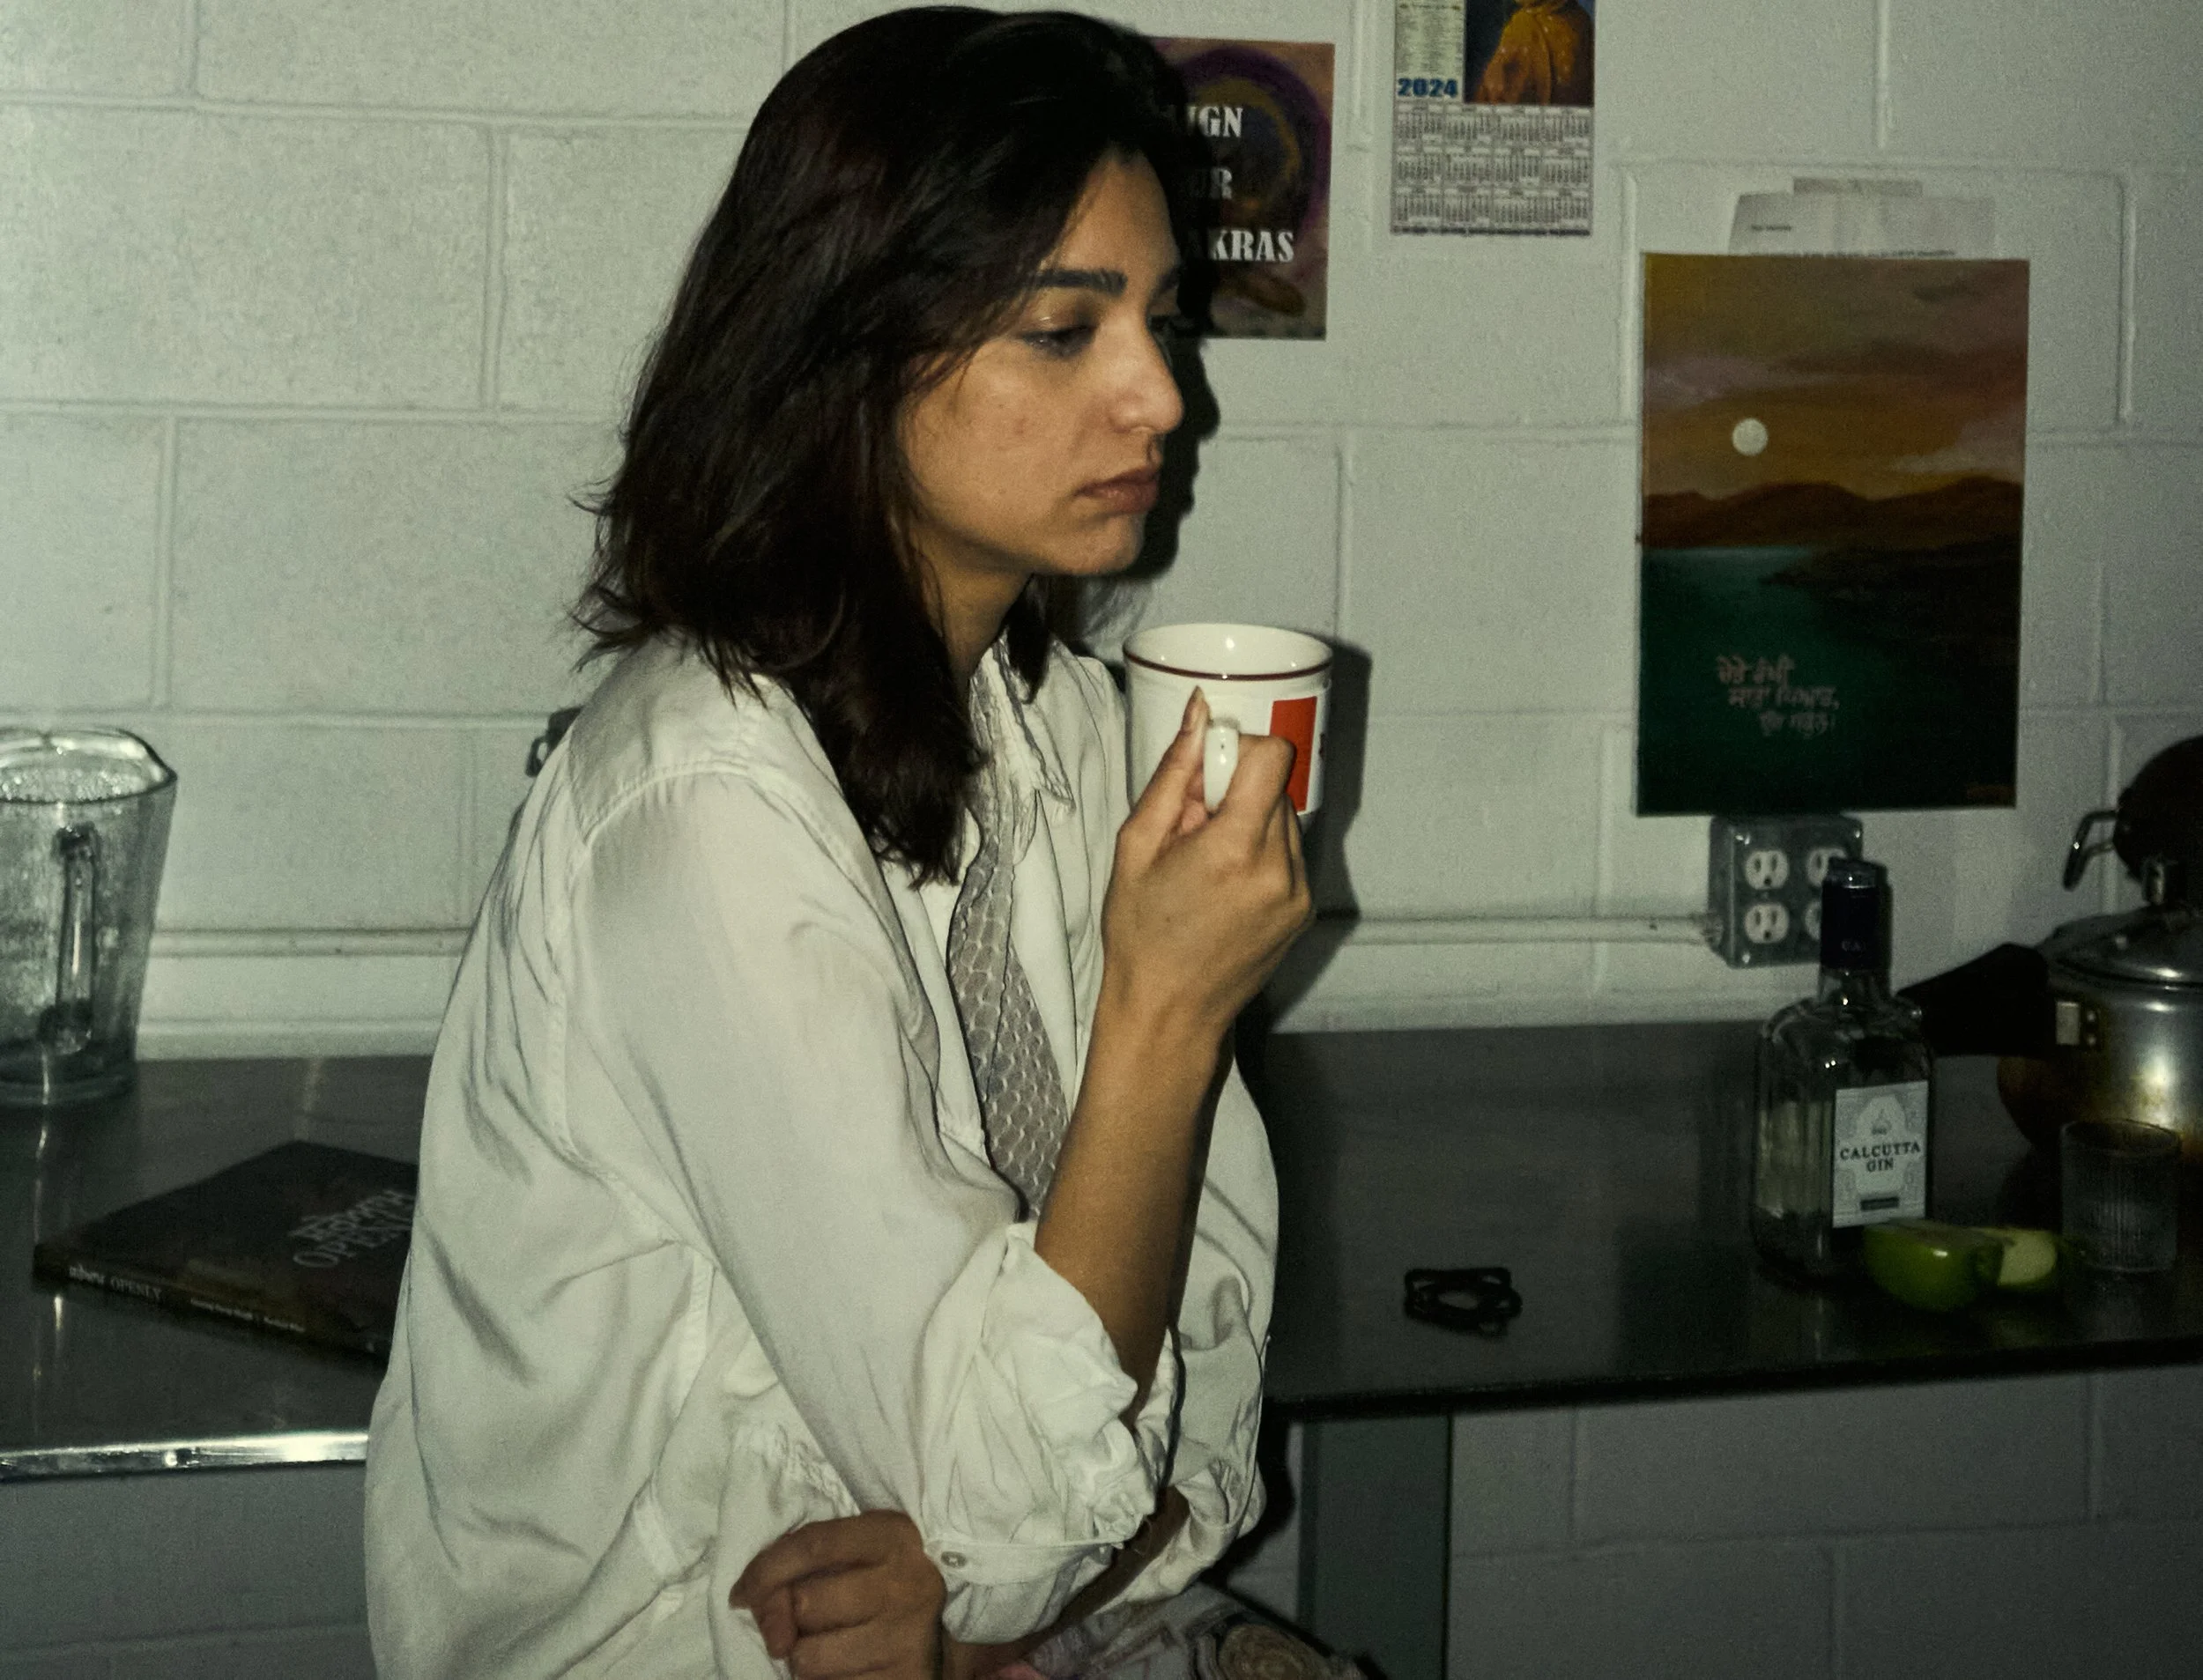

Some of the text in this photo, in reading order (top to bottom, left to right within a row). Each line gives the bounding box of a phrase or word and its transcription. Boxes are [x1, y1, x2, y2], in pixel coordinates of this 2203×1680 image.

[1397, 78, 1458, 99] 2024
[1186, 105, 1243, 138] IGN
[1208, 229, 1295, 263] KRAS
[1839, 1141, 1921, 1160] CALCUTTA
[1866, 1158, 1895, 1173] GIN
